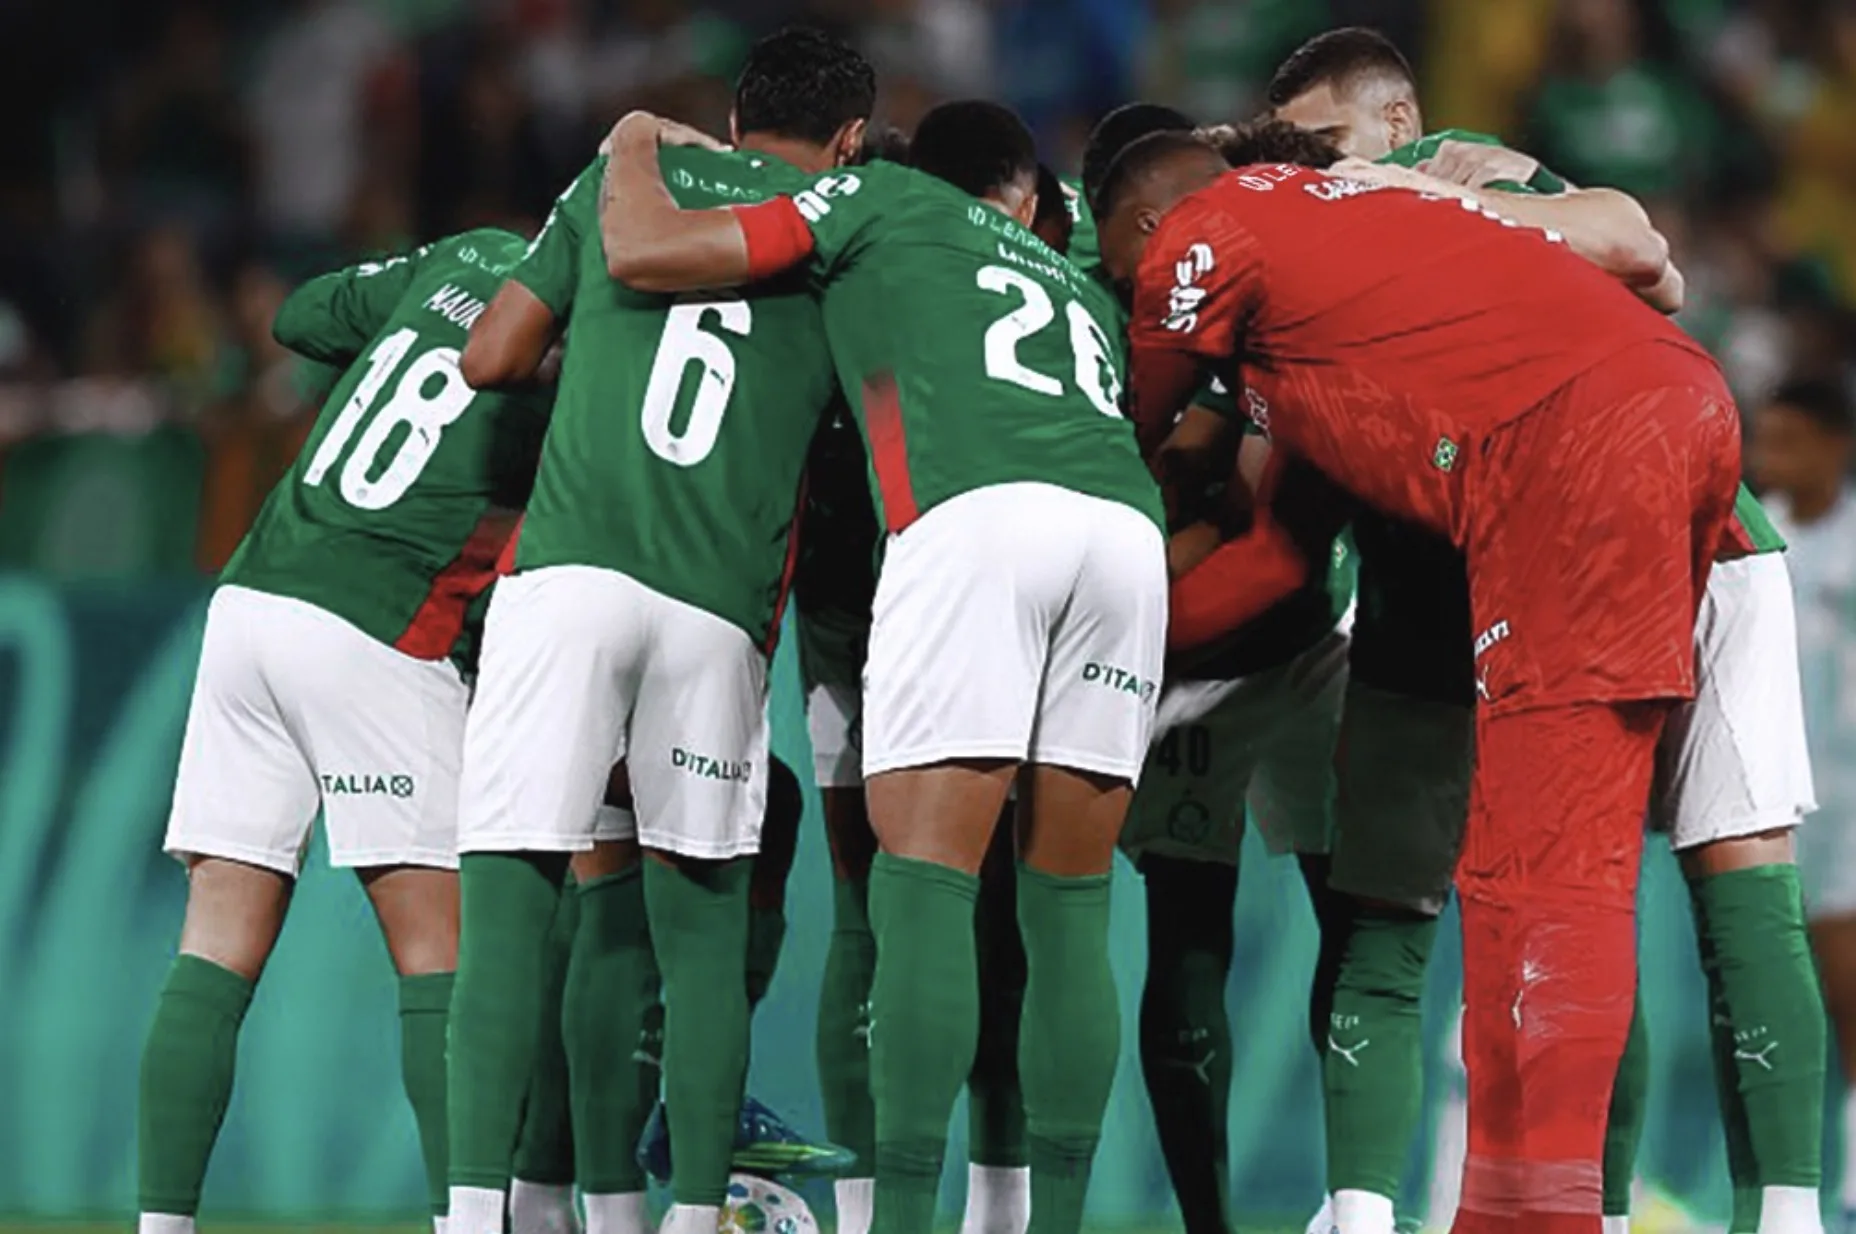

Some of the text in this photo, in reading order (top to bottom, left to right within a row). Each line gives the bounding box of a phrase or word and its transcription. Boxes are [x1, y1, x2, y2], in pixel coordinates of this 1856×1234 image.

[422, 283, 486, 331] MAUR
[641, 299, 752, 466] 6
[977, 264, 1124, 419] 26
[302, 326, 478, 511] 18
[321, 775, 388, 793] TALIA
